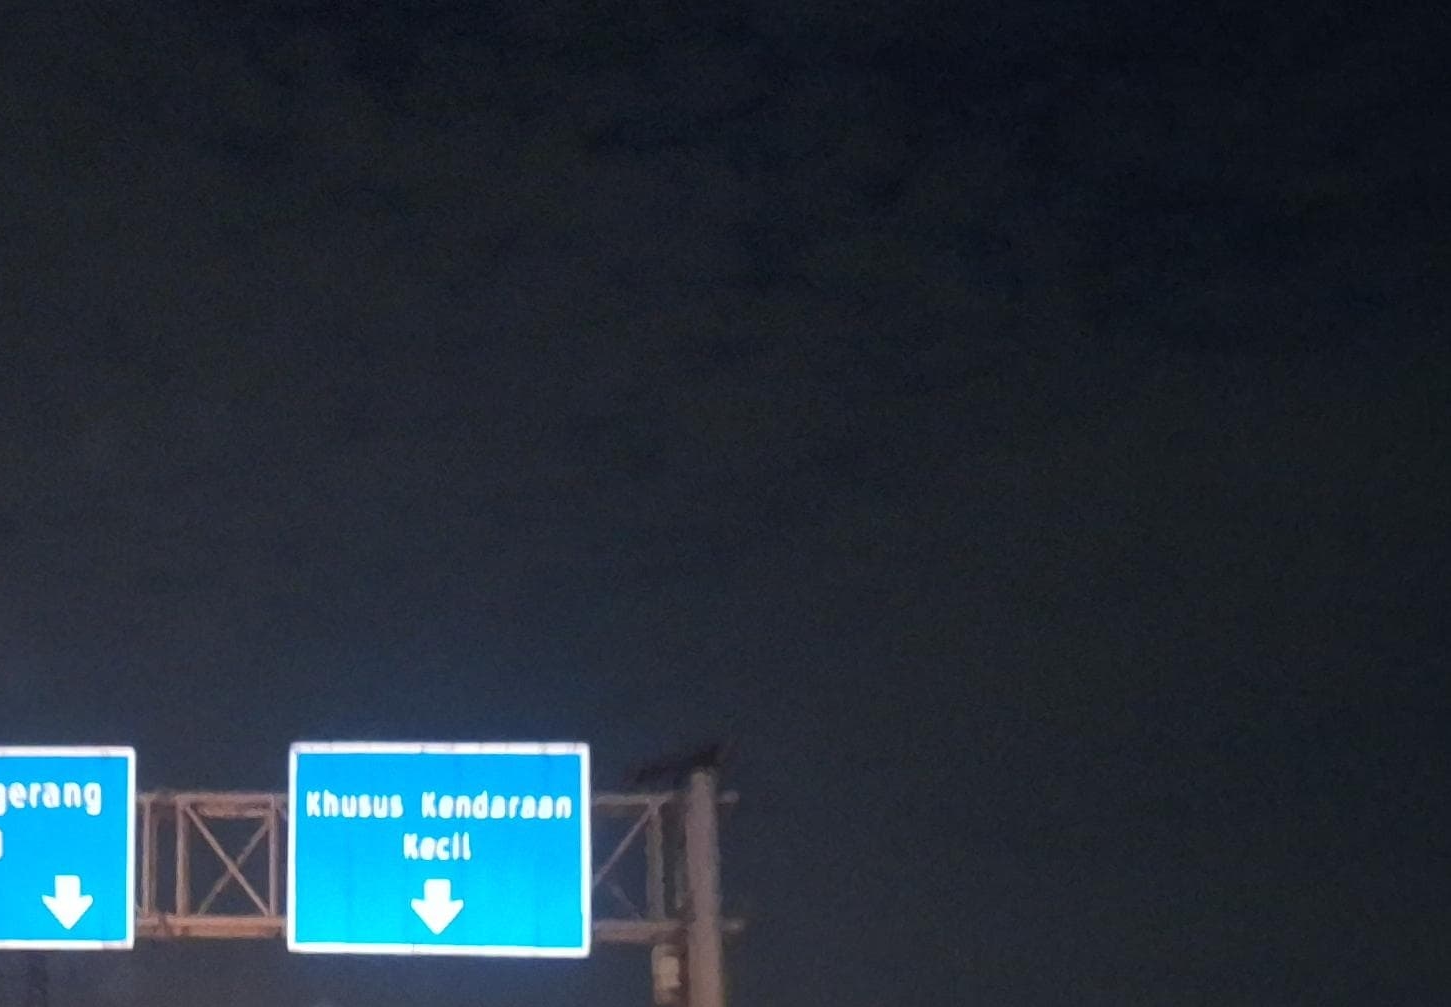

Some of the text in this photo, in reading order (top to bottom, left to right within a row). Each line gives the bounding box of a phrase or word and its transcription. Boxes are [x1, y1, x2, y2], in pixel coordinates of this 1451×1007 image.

[306, 789, 572, 819] Khusus Kendaraan
[403, 831, 472, 861] Kecil
